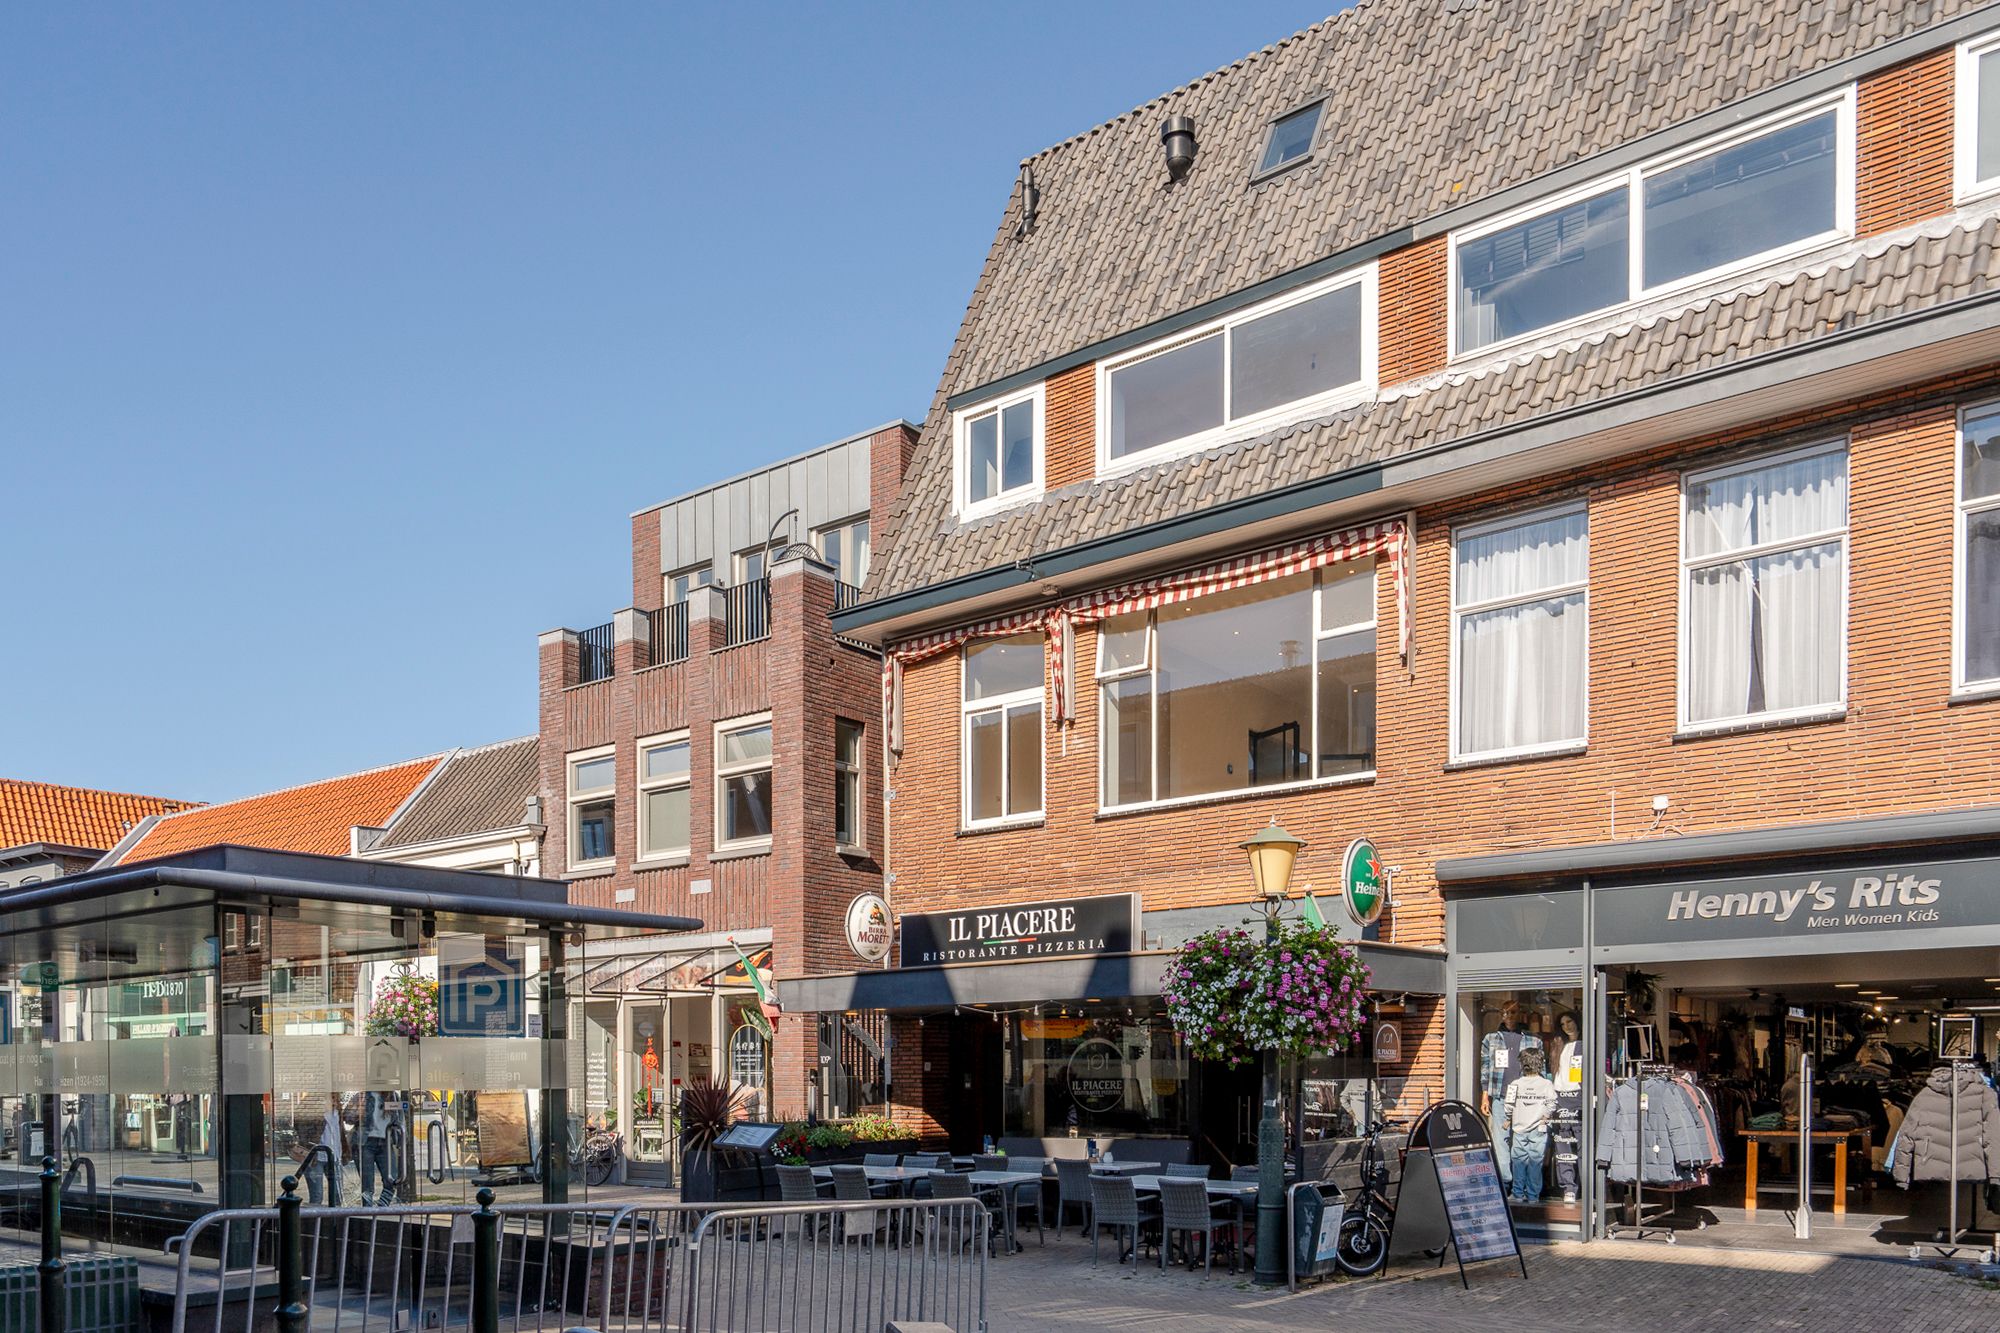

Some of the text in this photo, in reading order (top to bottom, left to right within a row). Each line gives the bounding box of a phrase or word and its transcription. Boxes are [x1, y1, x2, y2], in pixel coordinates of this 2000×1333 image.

[1667, 873, 1941, 922] Henny's Rits
[949, 906, 1076, 942] IL PIACERE
[1807, 908, 1940, 928] Men Women Kids
[857, 931, 890, 944] MORETT
[868, 926, 887, 935] BIRRA
[923, 938, 1106, 962] RISTORANTE PIZZERIA
[166, 981, 184, 997] 1870
[1072, 1079, 1122, 1091] IL PIACERE
[1441, 1163, 1491, 1178] Henny's Rits
